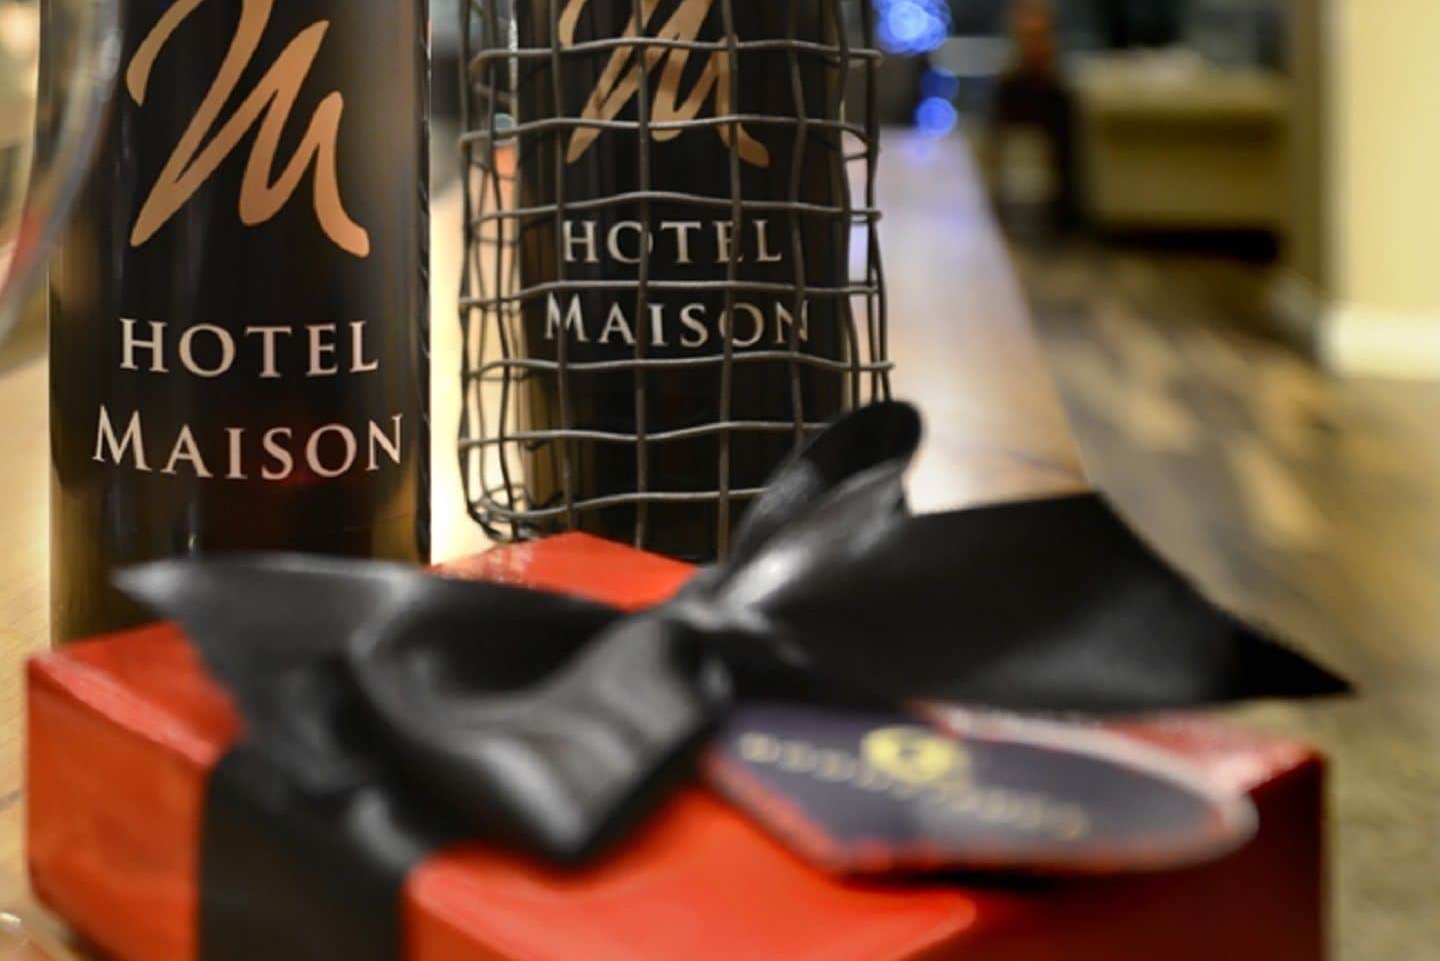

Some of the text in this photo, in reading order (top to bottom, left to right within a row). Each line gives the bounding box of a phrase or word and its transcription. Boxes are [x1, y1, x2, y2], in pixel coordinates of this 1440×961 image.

[561, 219, 783, 265] HOTEL
[119, 318, 380, 378] HOTEL
[543, 293, 809, 348] MAISON
[91, 404, 404, 480] MAISON
